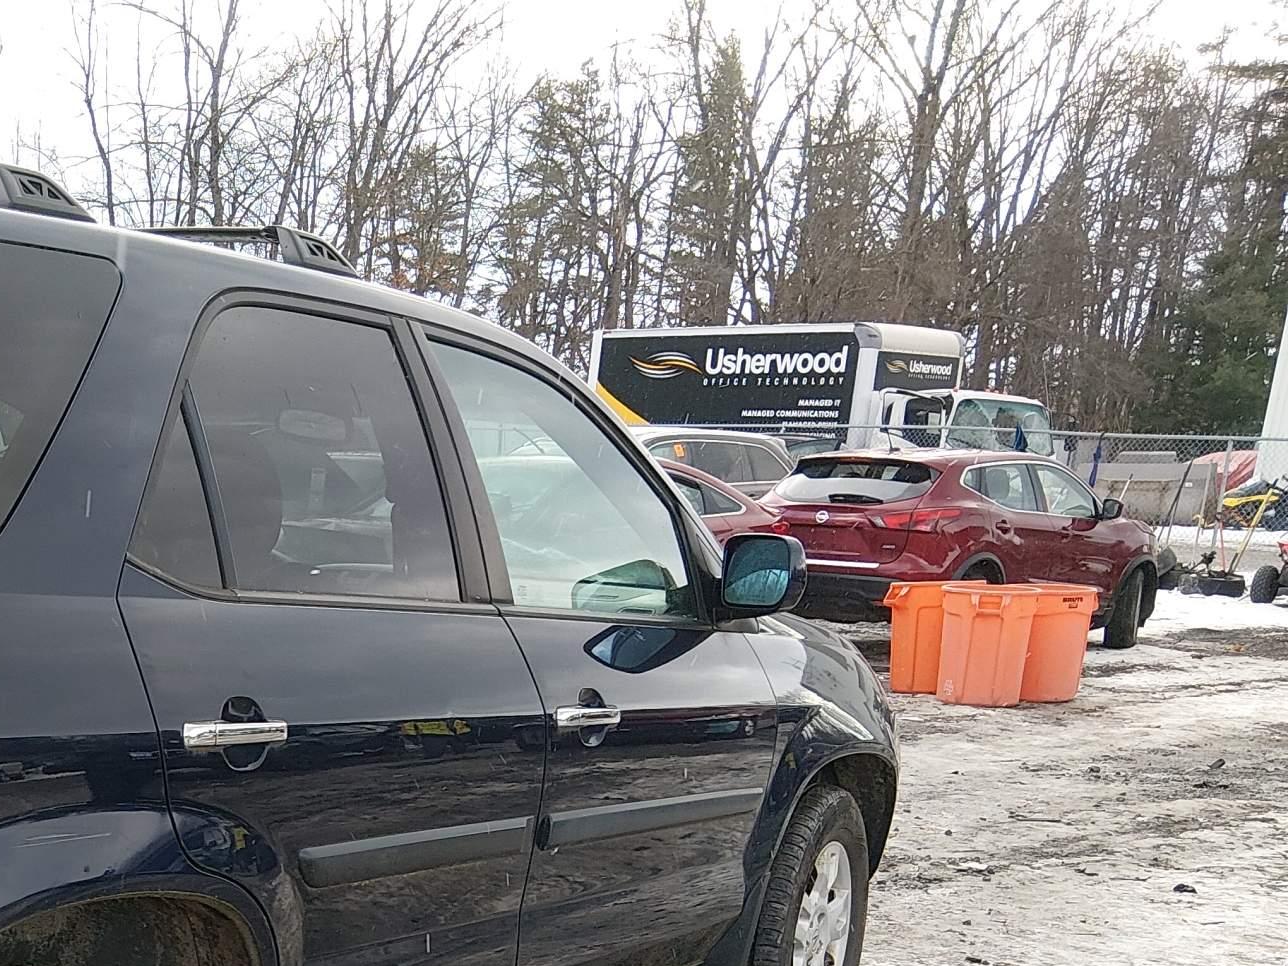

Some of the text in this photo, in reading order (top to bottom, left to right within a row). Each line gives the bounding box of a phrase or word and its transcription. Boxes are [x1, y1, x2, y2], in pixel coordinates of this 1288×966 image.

[705, 345, 849, 375] Usherwood
[909, 360, 953, 375] Usherwood
[703, 376, 845, 386] OFFICE TECHNOLOGY
[797, 399, 841, 407] MANAGED IT
[741, 409, 840, 418] MANAGED COMMUNICATIONS
